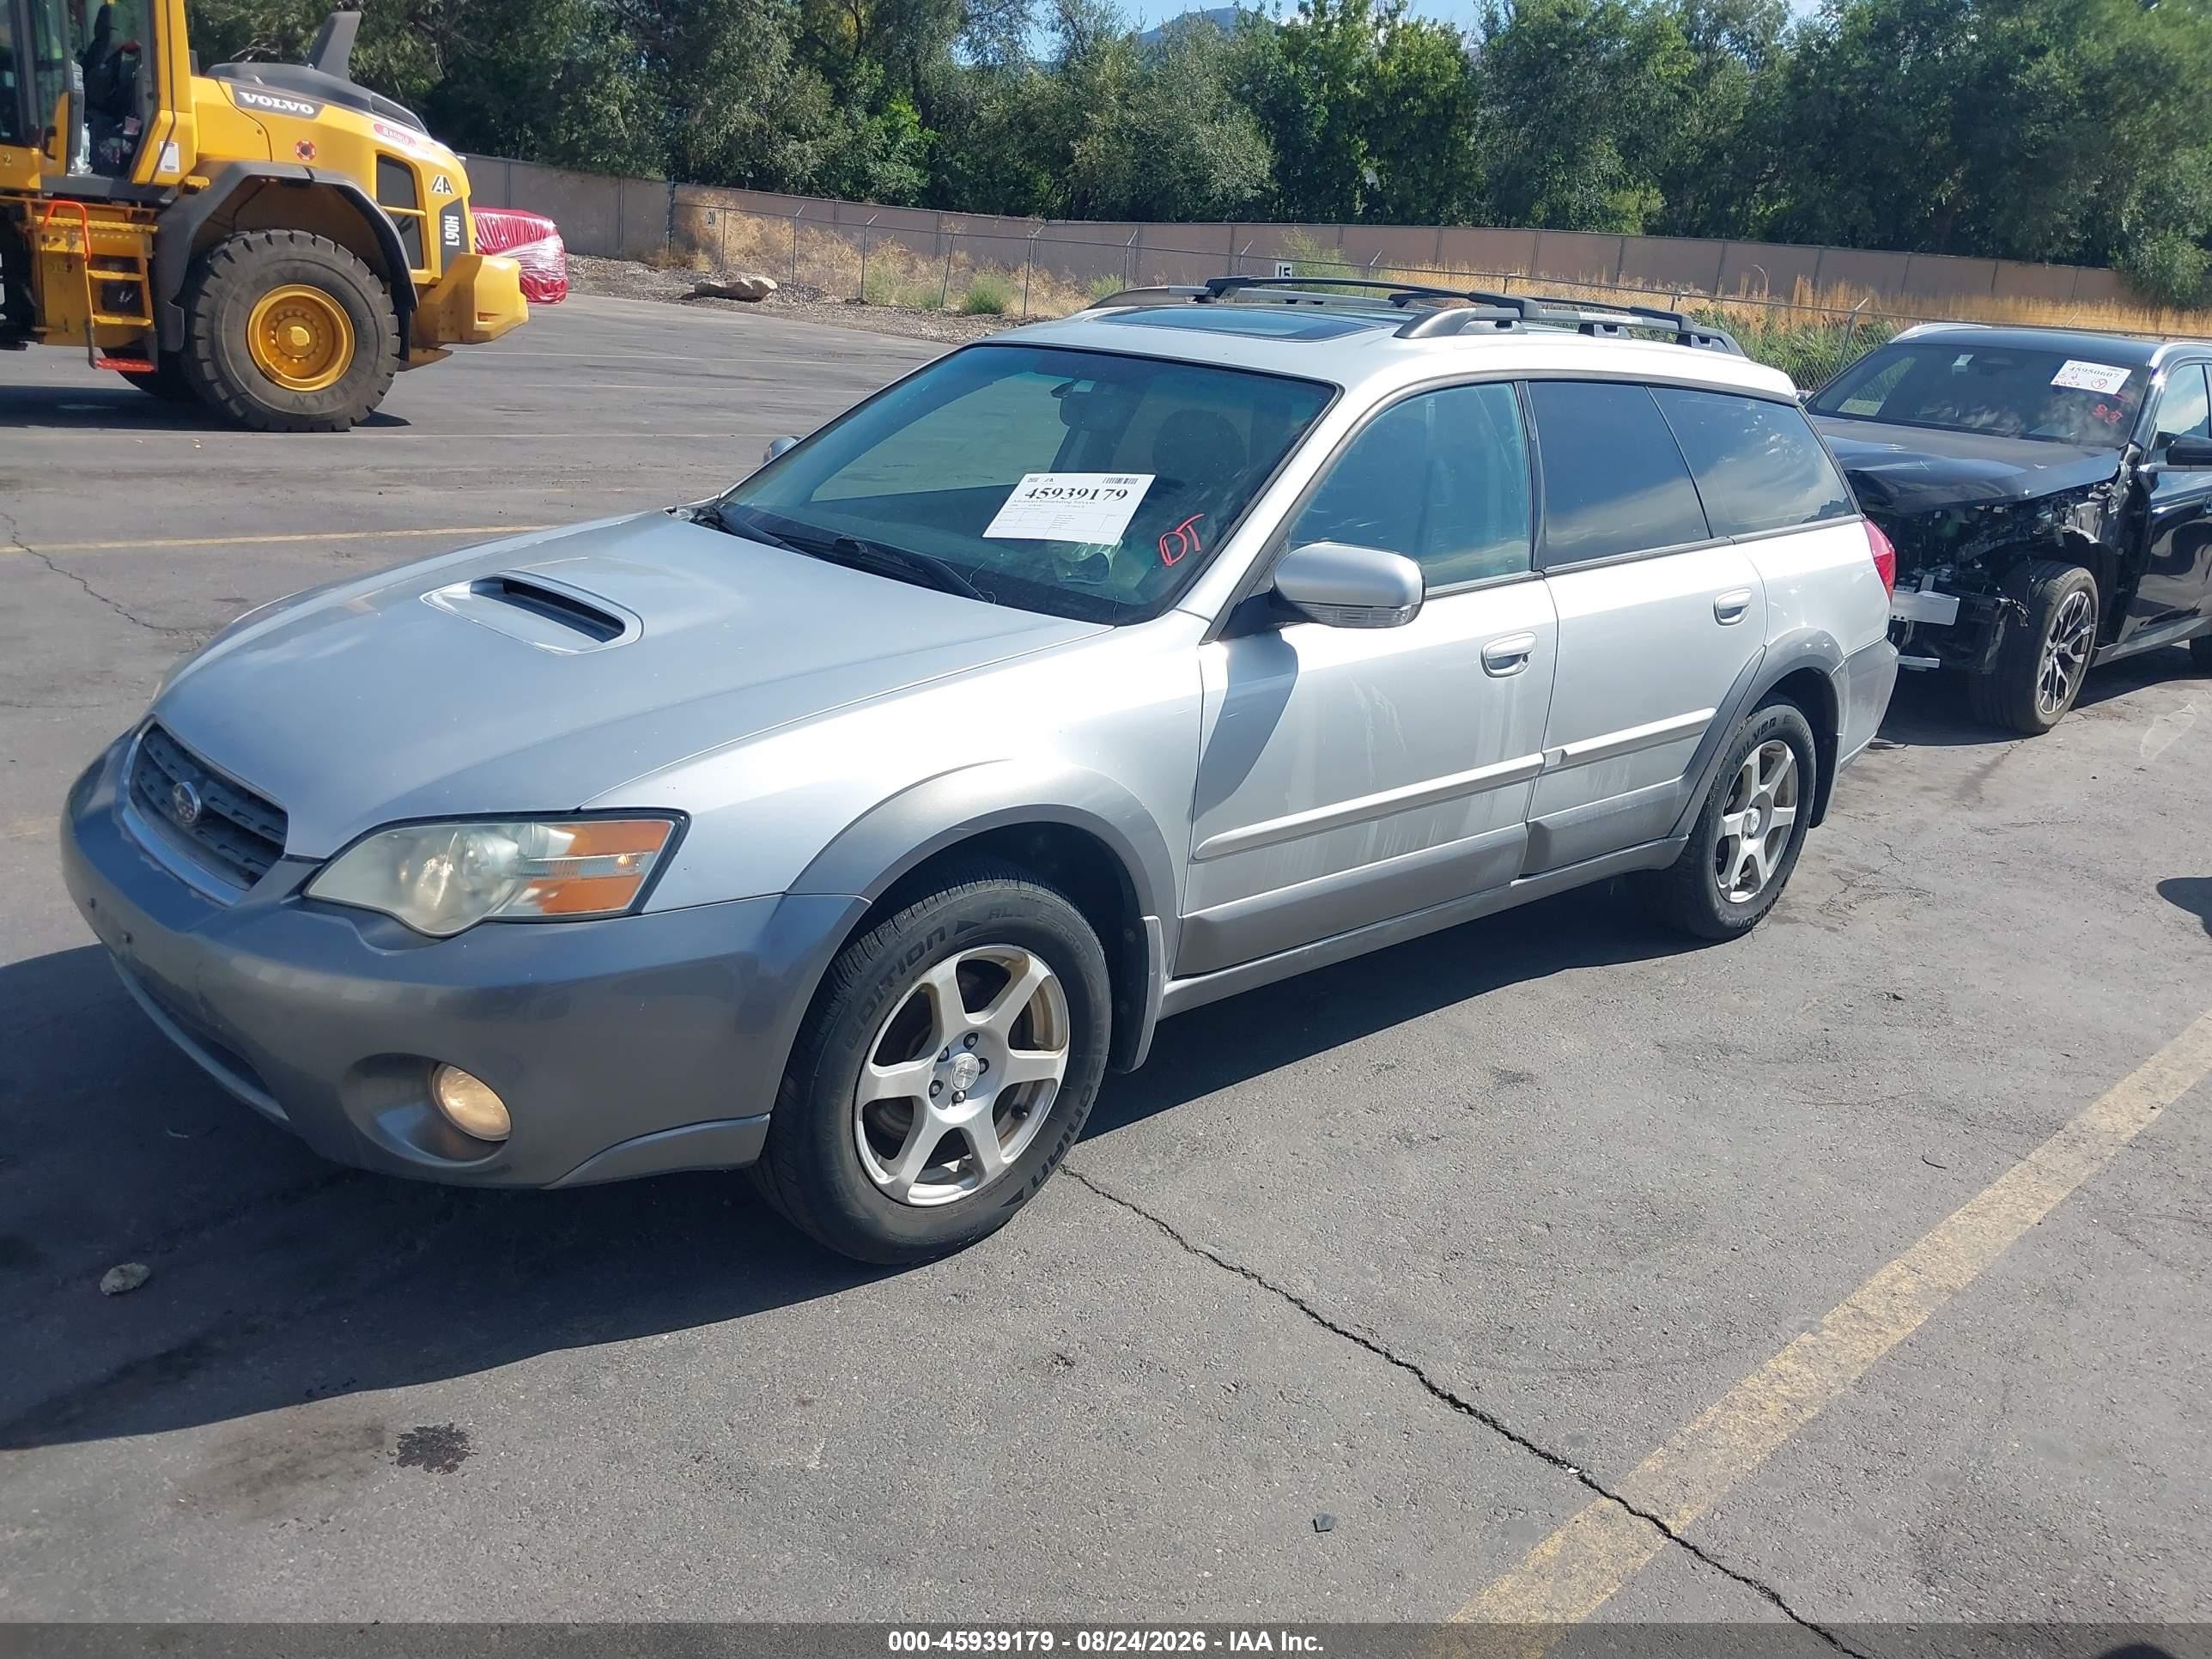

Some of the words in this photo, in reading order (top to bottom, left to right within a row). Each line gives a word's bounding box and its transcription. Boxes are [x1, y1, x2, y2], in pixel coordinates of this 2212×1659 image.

[239, 91, 315, 114] VOLVO
[444, 215, 460, 246] L90H
[1278, 265, 1291, 277] 15
[1024, 487, 1128, 501] 45939179
